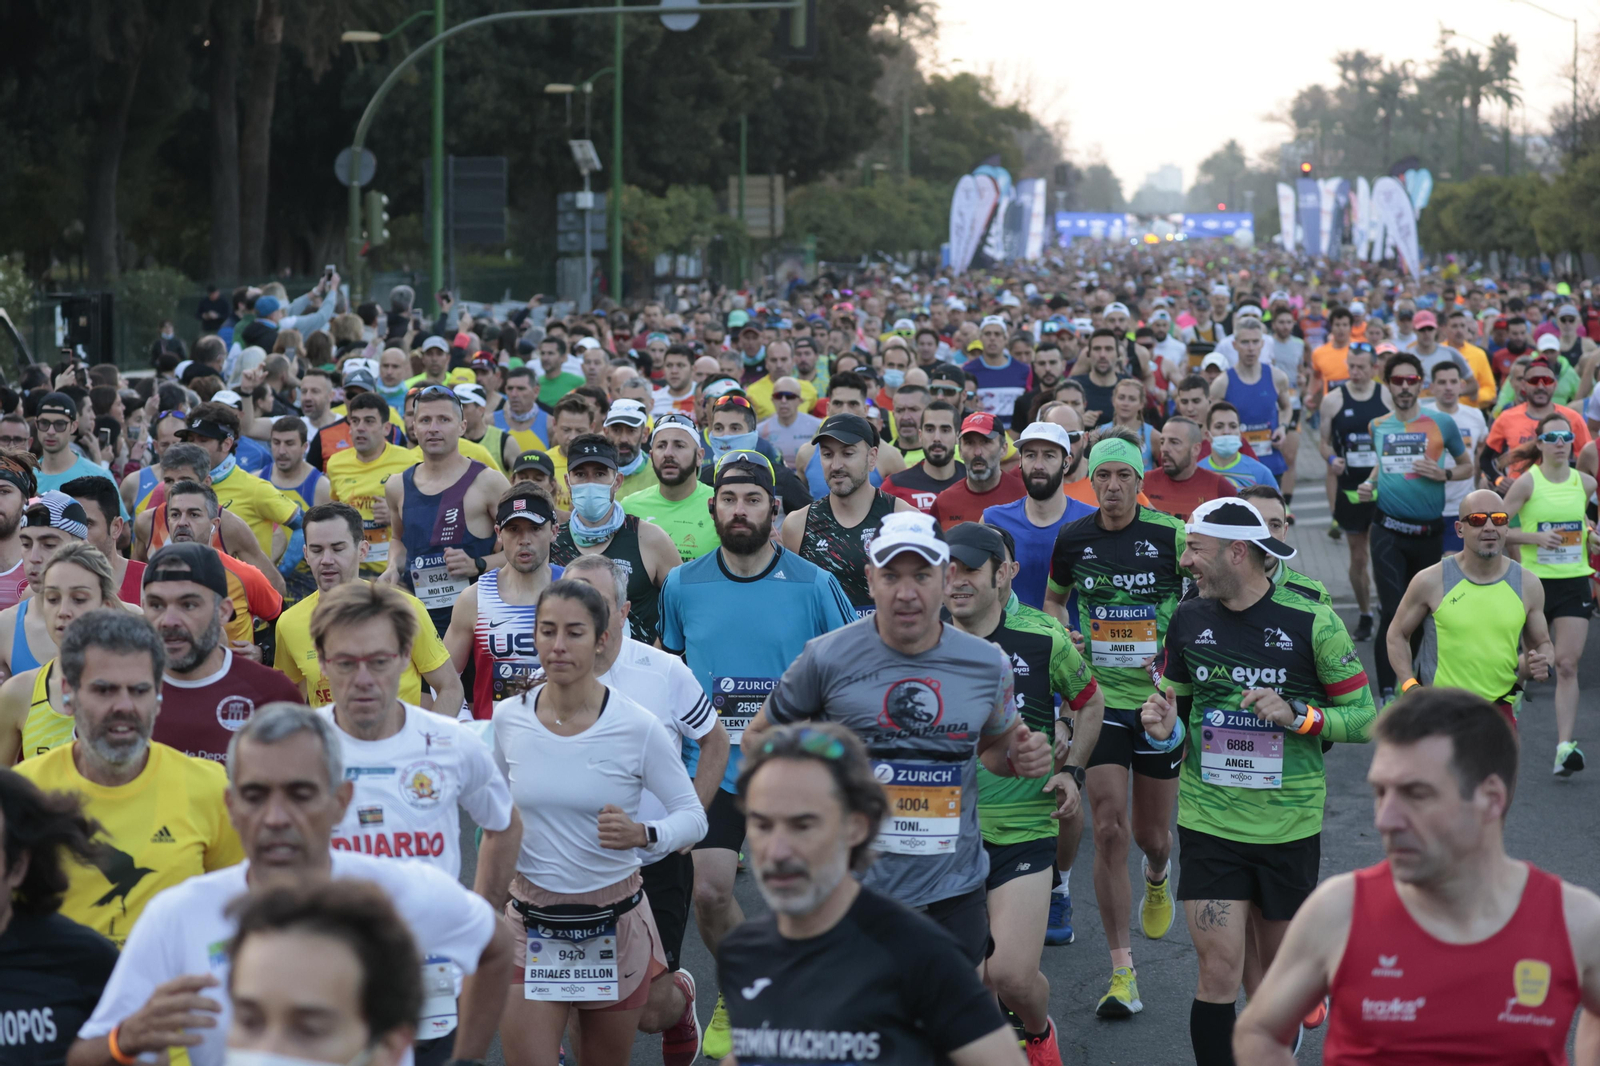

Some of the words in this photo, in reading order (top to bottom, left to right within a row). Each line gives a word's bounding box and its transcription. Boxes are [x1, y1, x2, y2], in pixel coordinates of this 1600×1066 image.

[428, 573, 448, 583] 8342
[1129, 587, 1157, 595] TRAIL
[1109, 609, 1147, 618] ZURICH
[1110, 629, 1132, 638] 5132
[489, 632, 538, 658] US
[737, 681, 778, 690] ZURICH
[737, 702, 762, 713] 2595
[1227, 715, 1273, 728] ZURICH
[1227, 739, 1254, 751] 6888
[1225, 758, 1255, 769] ANGEL
[897, 770, 952, 782] ZURICH
[896, 798, 929, 812] 4004
[894, 821, 929, 832] TONI...
[556, 924, 606, 940] ZURICH
[531, 969, 570, 979] BRIALES
[574, 968, 613, 979] BELLON
